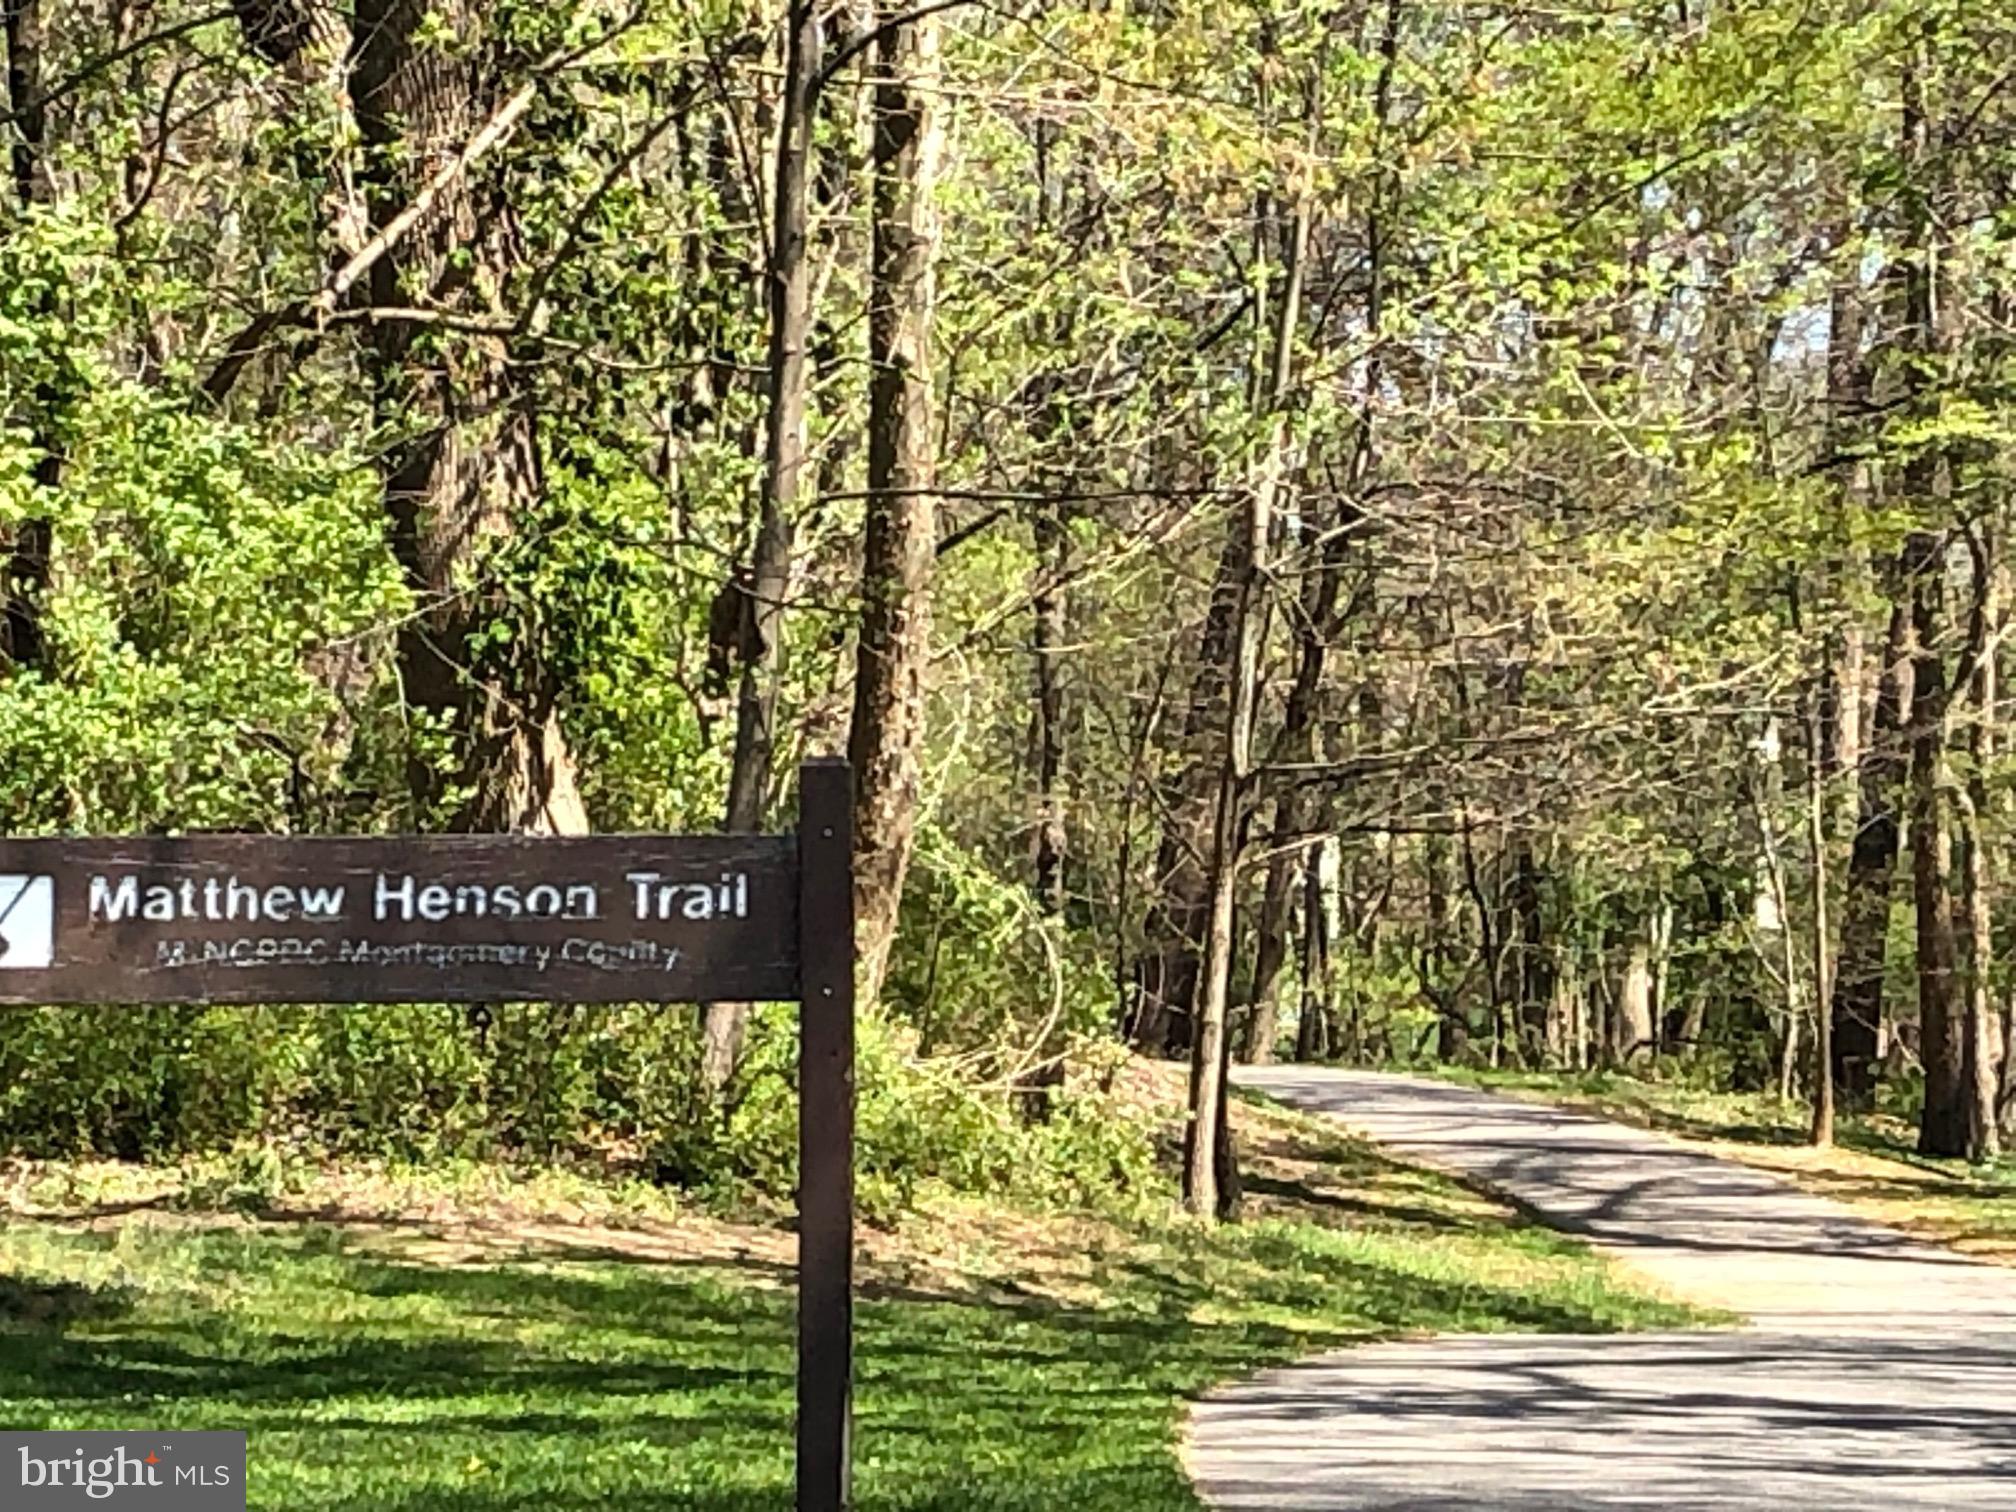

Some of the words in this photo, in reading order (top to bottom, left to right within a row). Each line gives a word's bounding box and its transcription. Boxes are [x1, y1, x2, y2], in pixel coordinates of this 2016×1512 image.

[88, 874, 345, 921] Matthew
[374, 873, 597, 921] Henson
[626, 872, 748, 920] Trail
[561, 938, 681, 972] County
